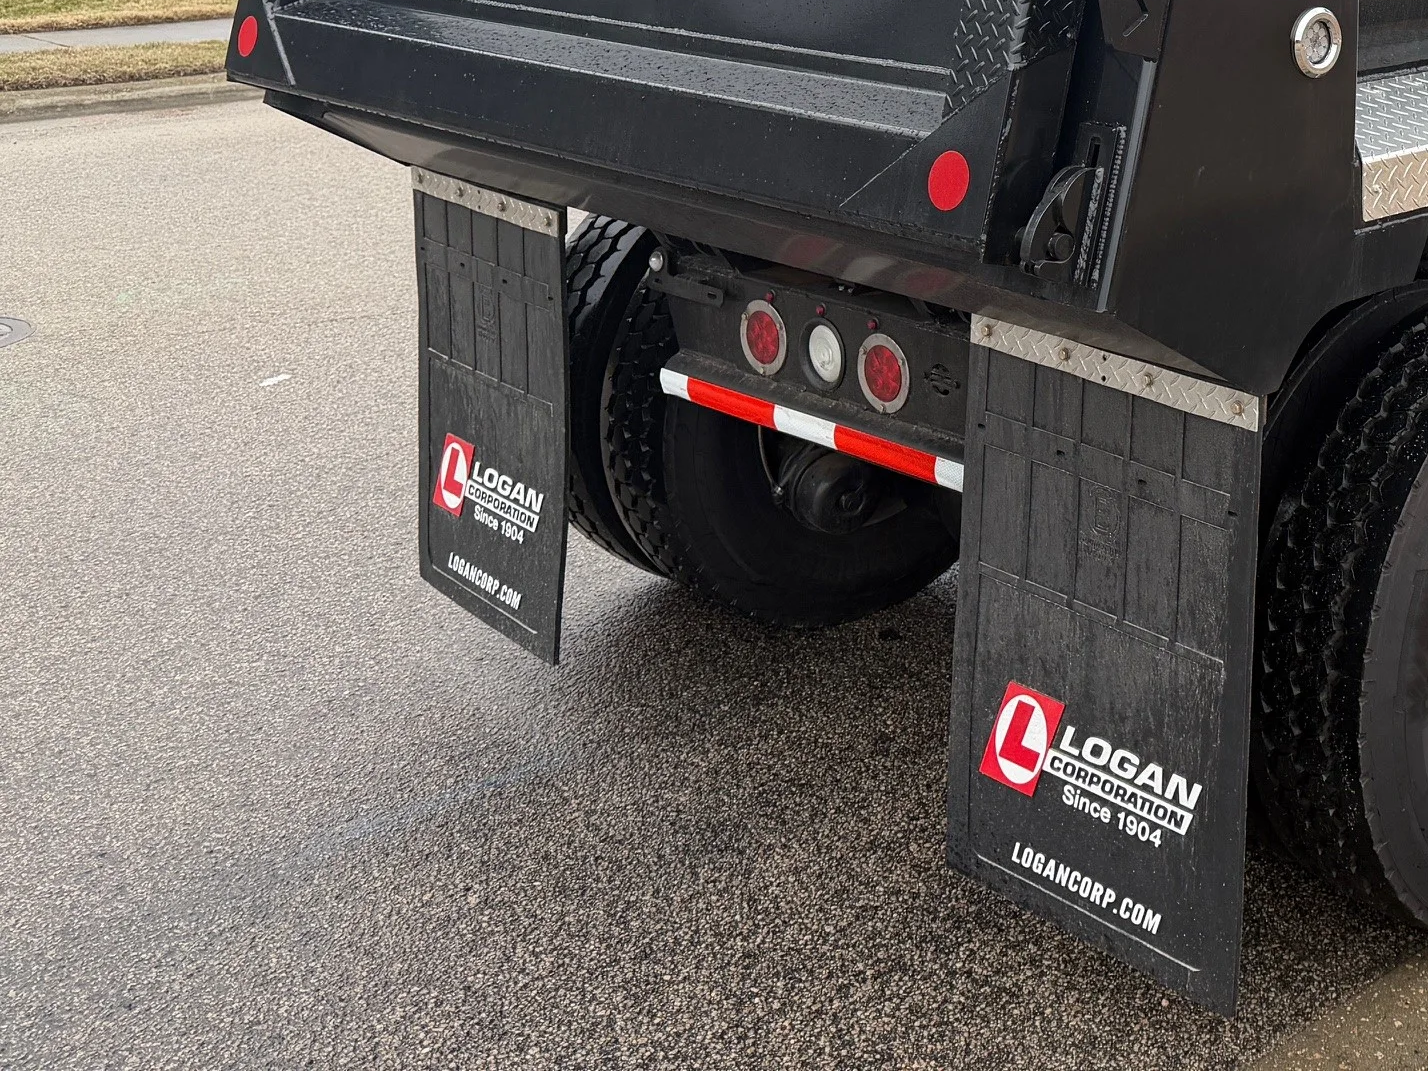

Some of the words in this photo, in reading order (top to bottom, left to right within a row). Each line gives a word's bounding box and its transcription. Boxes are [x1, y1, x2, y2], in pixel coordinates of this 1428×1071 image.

[443, 446, 463, 499] L
[472, 461, 544, 514] LOGAN
[467, 484, 535, 530] CORPORATION
[473, 505, 499, 531] Since
[500, 520, 524, 545] 1904
[448, 551, 522, 611] LOGANCORP.COM
[999, 699, 1041, 773] L
[1049, 753, 1186, 830] CORPORATION
[1059, 725, 1203, 810] LOGAN
[1062, 784, 1111, 824] Since
[1117, 811, 1162, 848] 1904
[1011, 841, 1162, 935] LOGANCORP.COM
